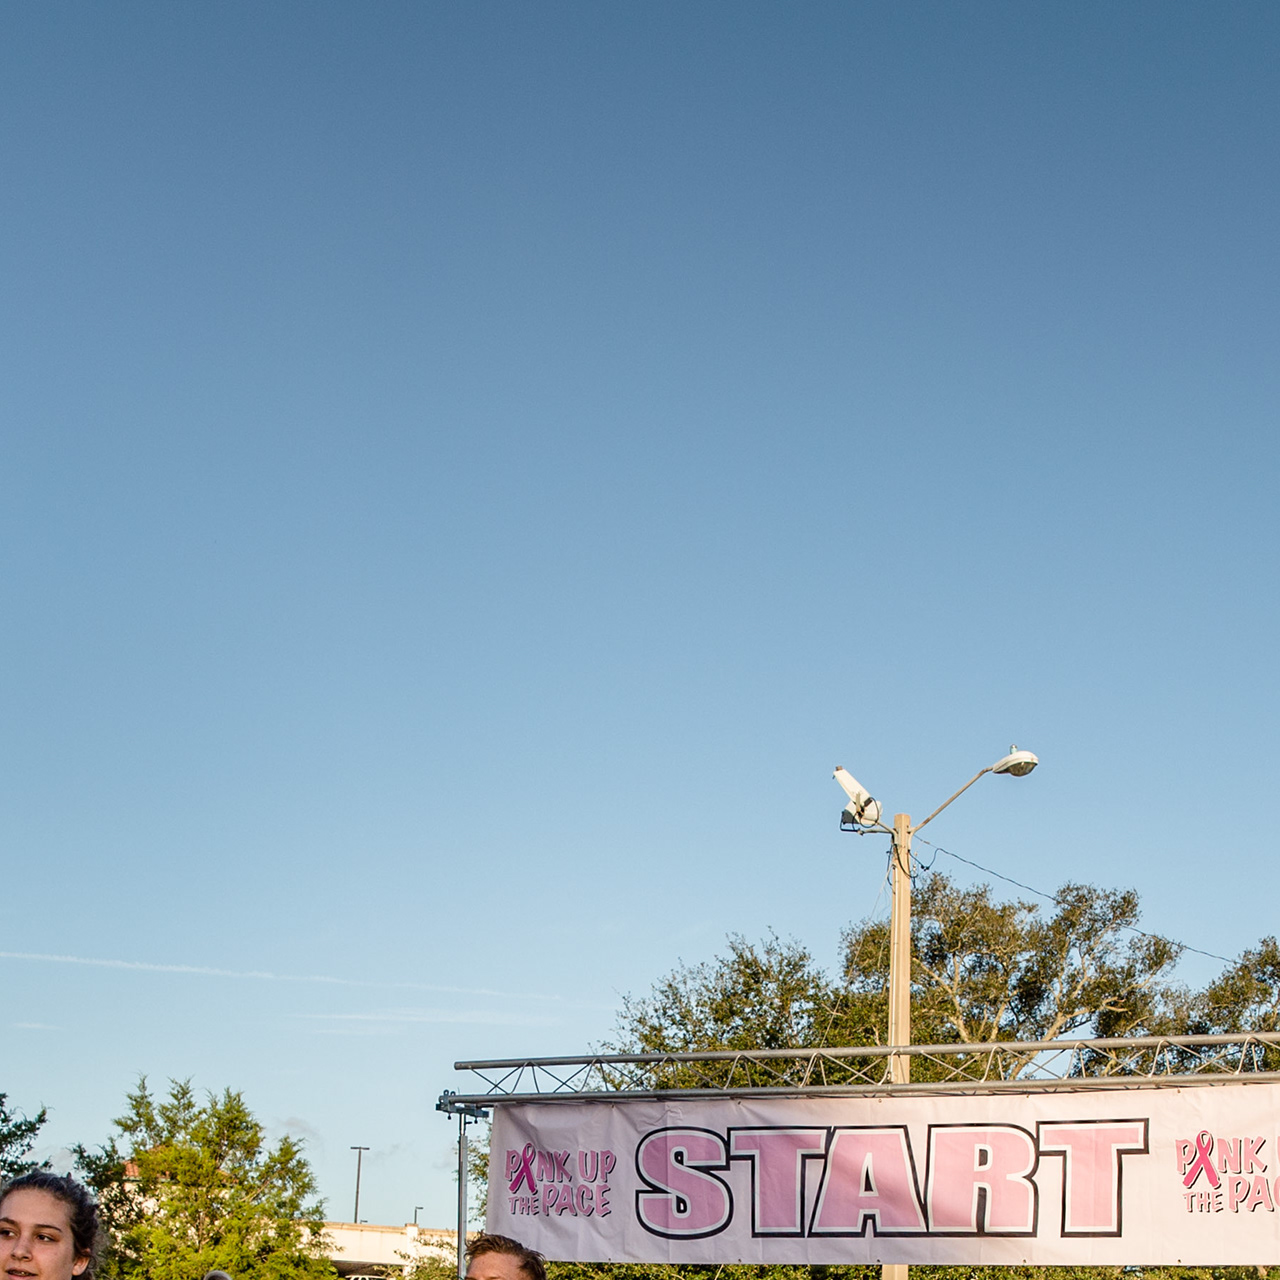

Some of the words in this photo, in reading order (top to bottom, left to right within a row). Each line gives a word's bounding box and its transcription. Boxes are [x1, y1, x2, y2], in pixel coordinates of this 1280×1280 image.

[578, 1149, 617, 1183] UP
[635, 1118, 1149, 1240] START
[508, 1196, 539, 1215] THE
[542, 1184, 612, 1217] PACE
[1183, 1191, 1224, 1213] THE
